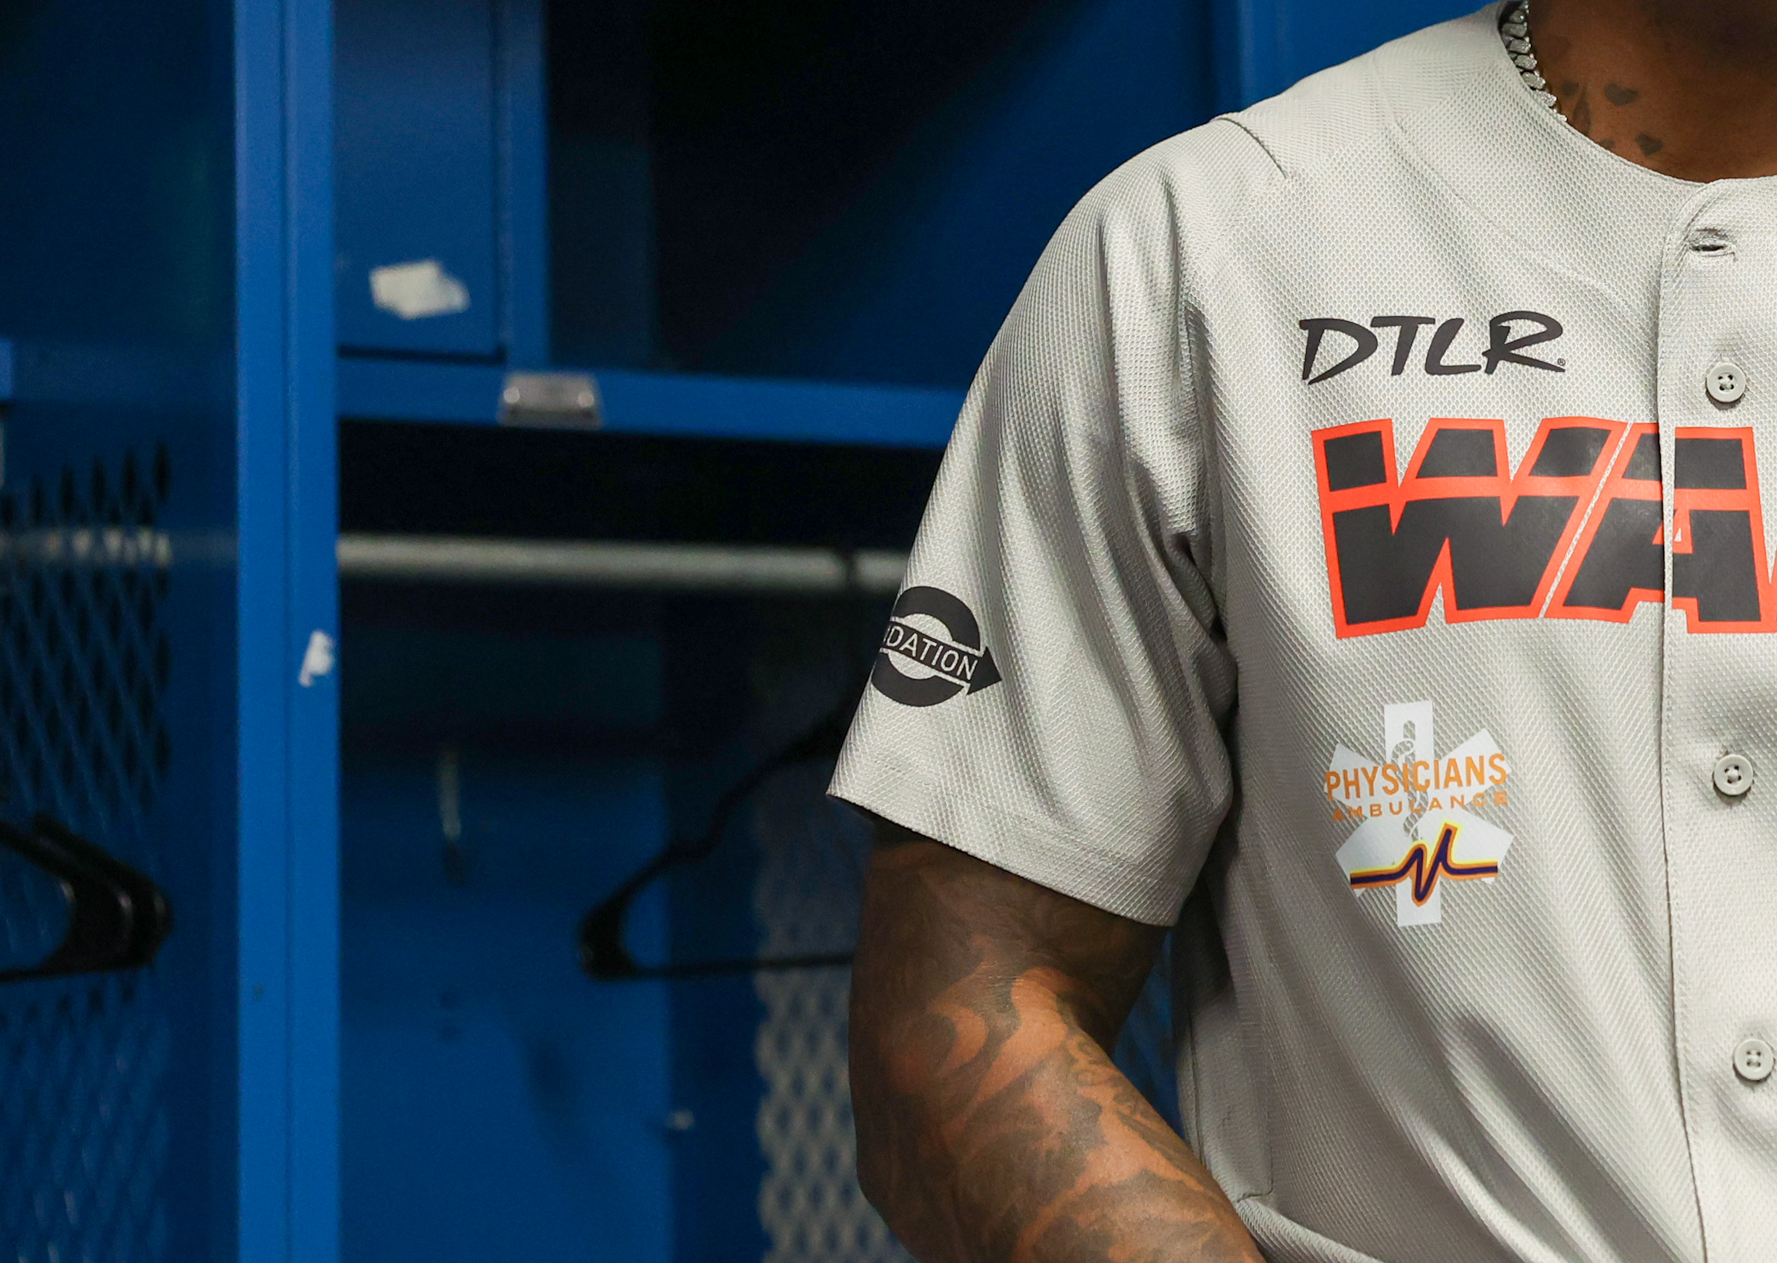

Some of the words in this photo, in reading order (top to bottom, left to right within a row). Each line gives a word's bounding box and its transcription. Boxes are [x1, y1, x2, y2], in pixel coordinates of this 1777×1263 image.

[1299, 310, 1567, 386] DTLR
[884, 624, 978, 681] DATION
[1324, 753, 1508, 802] PHYSICIANS
[1331, 790, 1510, 822] AMBULANCE
